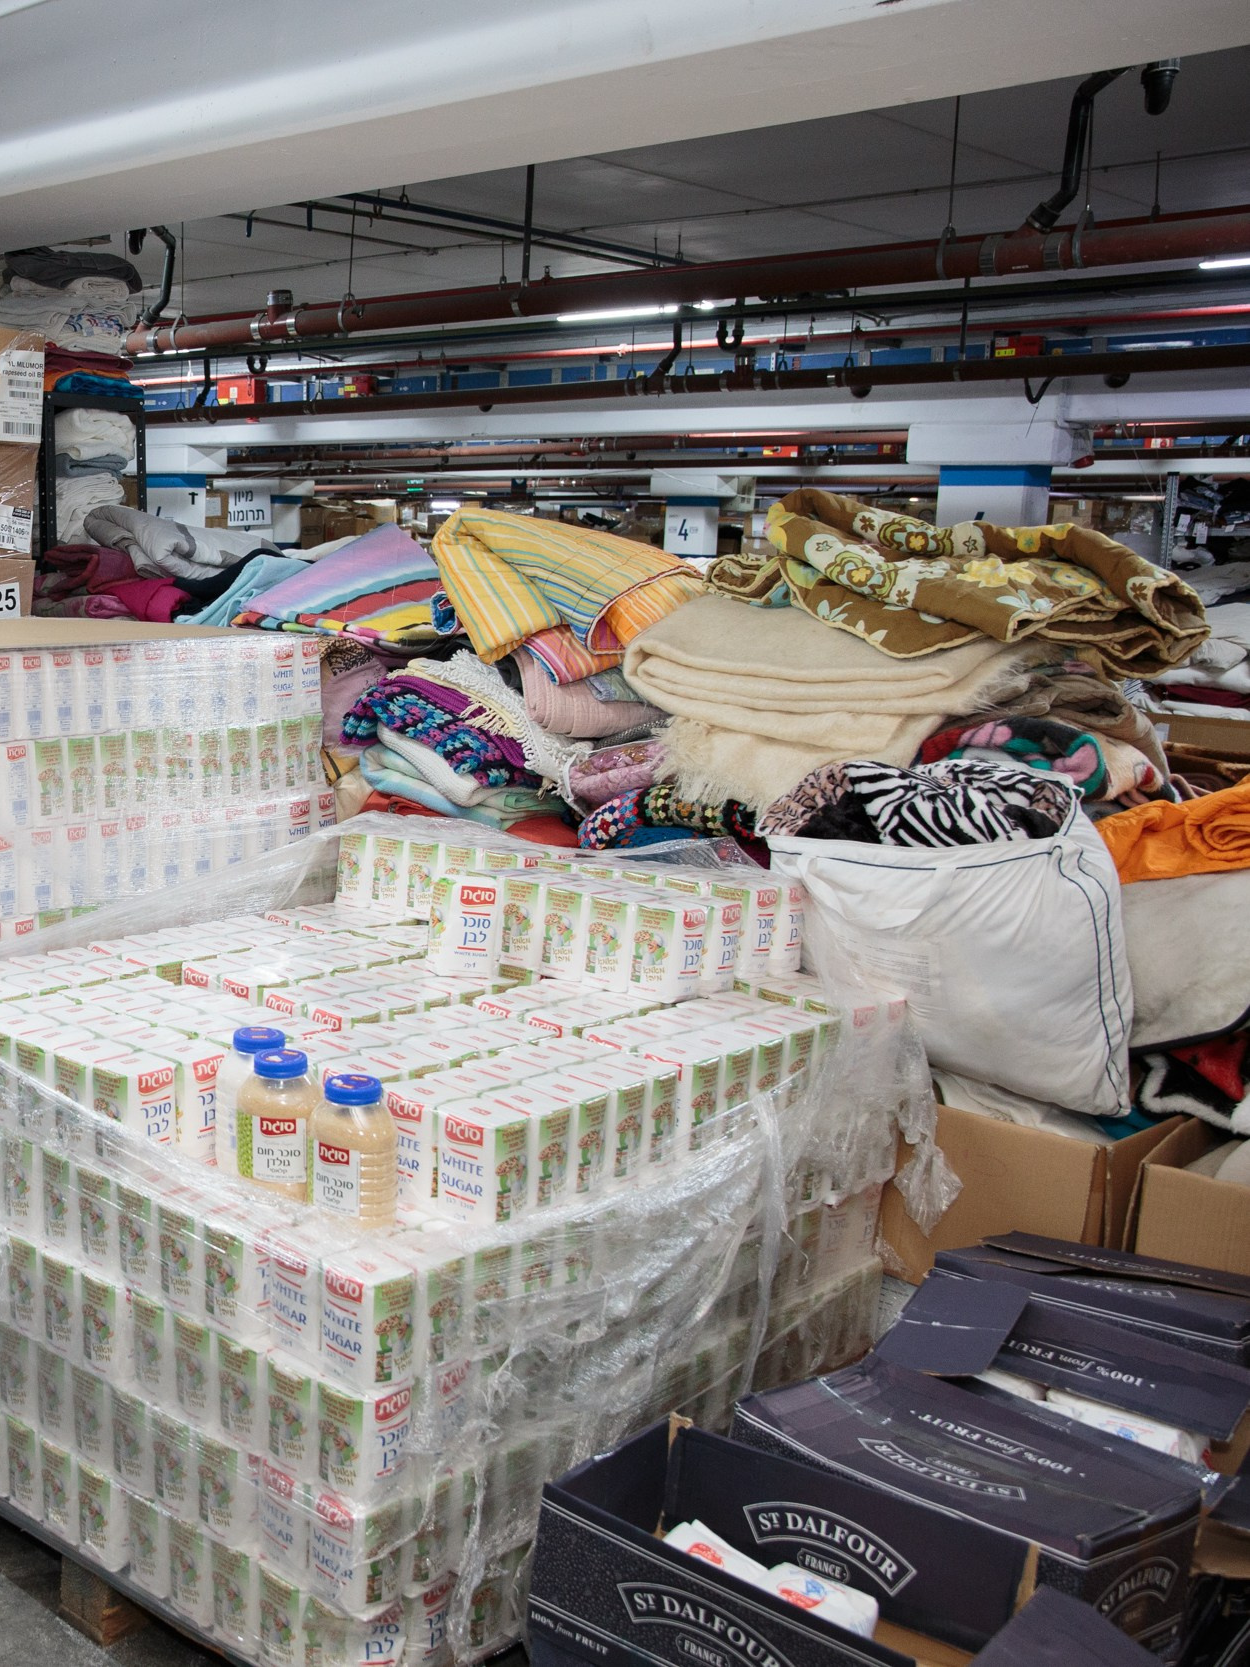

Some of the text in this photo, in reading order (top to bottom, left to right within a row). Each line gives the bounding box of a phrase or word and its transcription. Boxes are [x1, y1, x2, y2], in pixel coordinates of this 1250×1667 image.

[17, 361, 44, 370] MILUMOR
[234, 490, 254, 506] מיון
[678, 519, 689, 541] 4
[23, 658, 41, 667] סוגת
[7, 748, 26, 757] סוגת
[462, 887, 495, 902] סוגת
[459, 916, 491, 929] סוכר
[684, 911, 706, 924] סוגת
[462, 930, 488, 946] לבן
[682, 938, 703, 951] סוכר
[757, 932, 773, 948] לבן
[683, 953, 700, 969] לבן
[721, 949, 737, 964] לבן
[184, 969, 209, 986] סוגת
[267, 997, 293, 1014] סוגת
[313, 1012, 341, 1030] סוגת
[196, 1056, 223, 1076] וגת
[140, 1069, 172, 1089] סוגת
[140, 1101, 172, 1120] סוכר
[387, 1096, 421, 1118] סוגת
[147, 1117, 169, 1136] לבן
[261, 1119, 296, 1135] סוגת
[446, 1119, 482, 1142] סוגת
[257, 1146, 301, 1158] סוכר חום
[398, 1135, 421, 1152] ITE
[266, 1157, 291, 1169] גולדן
[318, 1146, 350, 1164] סוגת
[398, 1156, 421, 1172] GAR
[442, 1152, 484, 1177] WHITE
[316, 1172, 330, 1184] חום
[332, 1177, 354, 1190] סוכר
[441, 1172, 484, 1197] SUGAR
[323, 1184, 345, 1199] גולדן
[271, 1278, 307, 1306] WHITE
[326, 1272, 361, 1299] סוגת
[270, 1299, 307, 1326] SUGAR
[323, 1306, 363, 1335] WHITE
[322, 1325, 363, 1354] SUGAR
[1008, 1339, 1146, 1387] 100% from FRUI
[378, 1390, 411, 1416] סוגת
[918, 1411, 1074, 1476] 100% from FRUIT
[873, 1441, 980, 1491] DALFOUR
[758, 1512, 900, 1582] ST DALFOUR
[804, 1553, 842, 1578] FRANCE
[530, 1609, 609, 1656] 100% from FRUIT
[632, 1591, 782, 1667] ST DALFOUR
[365, 1637, 395, 1661] לבן
[683, 1639, 724, 1667] FRANCE
